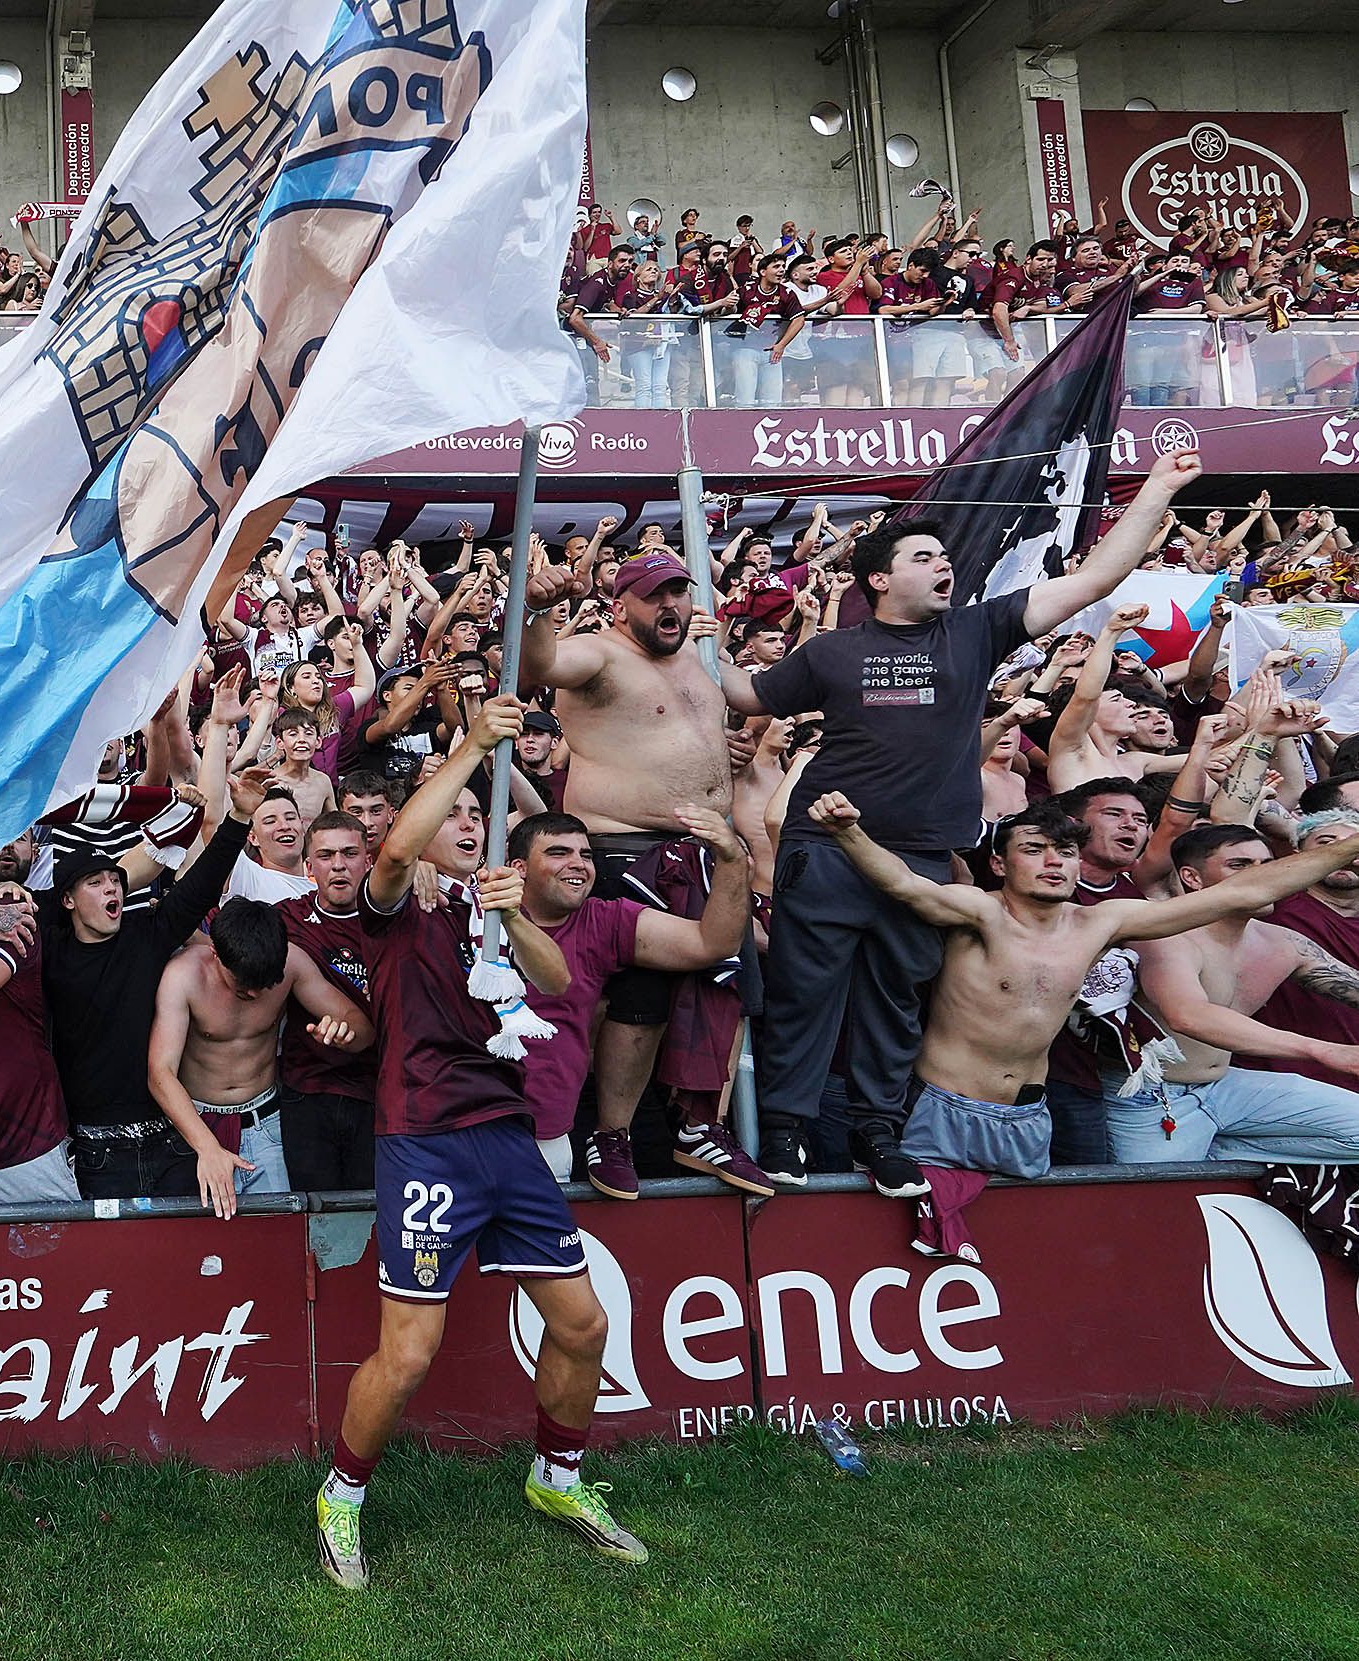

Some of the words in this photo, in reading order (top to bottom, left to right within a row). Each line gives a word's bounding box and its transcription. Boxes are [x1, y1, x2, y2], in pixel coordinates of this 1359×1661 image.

[65, 123, 82, 196] Deputación
[78, 123, 91, 196] Pontevedra
[1042, 133, 1059, 204] Deputación
[1054, 133, 1071, 204] Pontevedra
[1148, 163, 1284, 197] Estrella
[591, 432, 648, 451] Radio
[750, 416, 945, 467] Estrella
[862, 667, 889, 675] one
[863, 656, 891, 665] one
[862, 678, 890, 687] one
[894, 676, 933, 687] beer.
[402, 1180, 454, 1233] 22
[415, 1233, 441, 1242] XUNTA
[415, 1241, 427, 1249] DE
[662, 1264, 1005, 1381] ence
[831, 1402, 854, 1432] &
[864, 1395, 1014, 1432] CELULOSA
